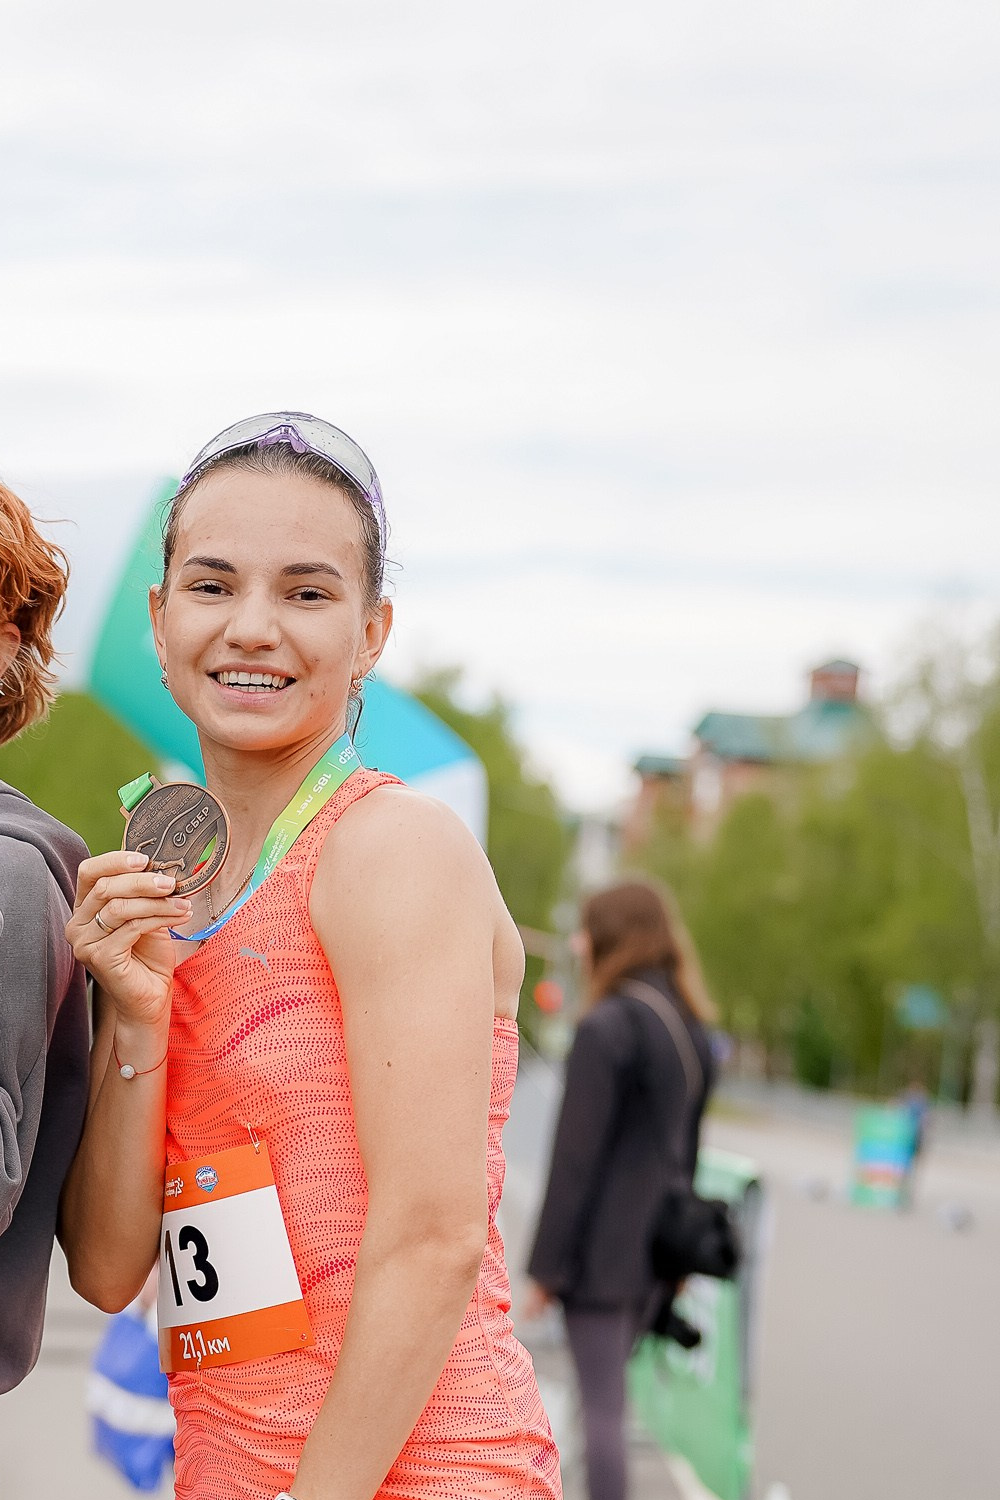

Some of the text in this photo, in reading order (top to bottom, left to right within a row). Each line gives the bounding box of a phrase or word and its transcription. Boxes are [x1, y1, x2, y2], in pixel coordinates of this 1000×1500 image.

[297, 773, 332, 816] 185 лет
[185, 806, 210, 834] СБЕР
[165, 1225, 219, 1307] 13
